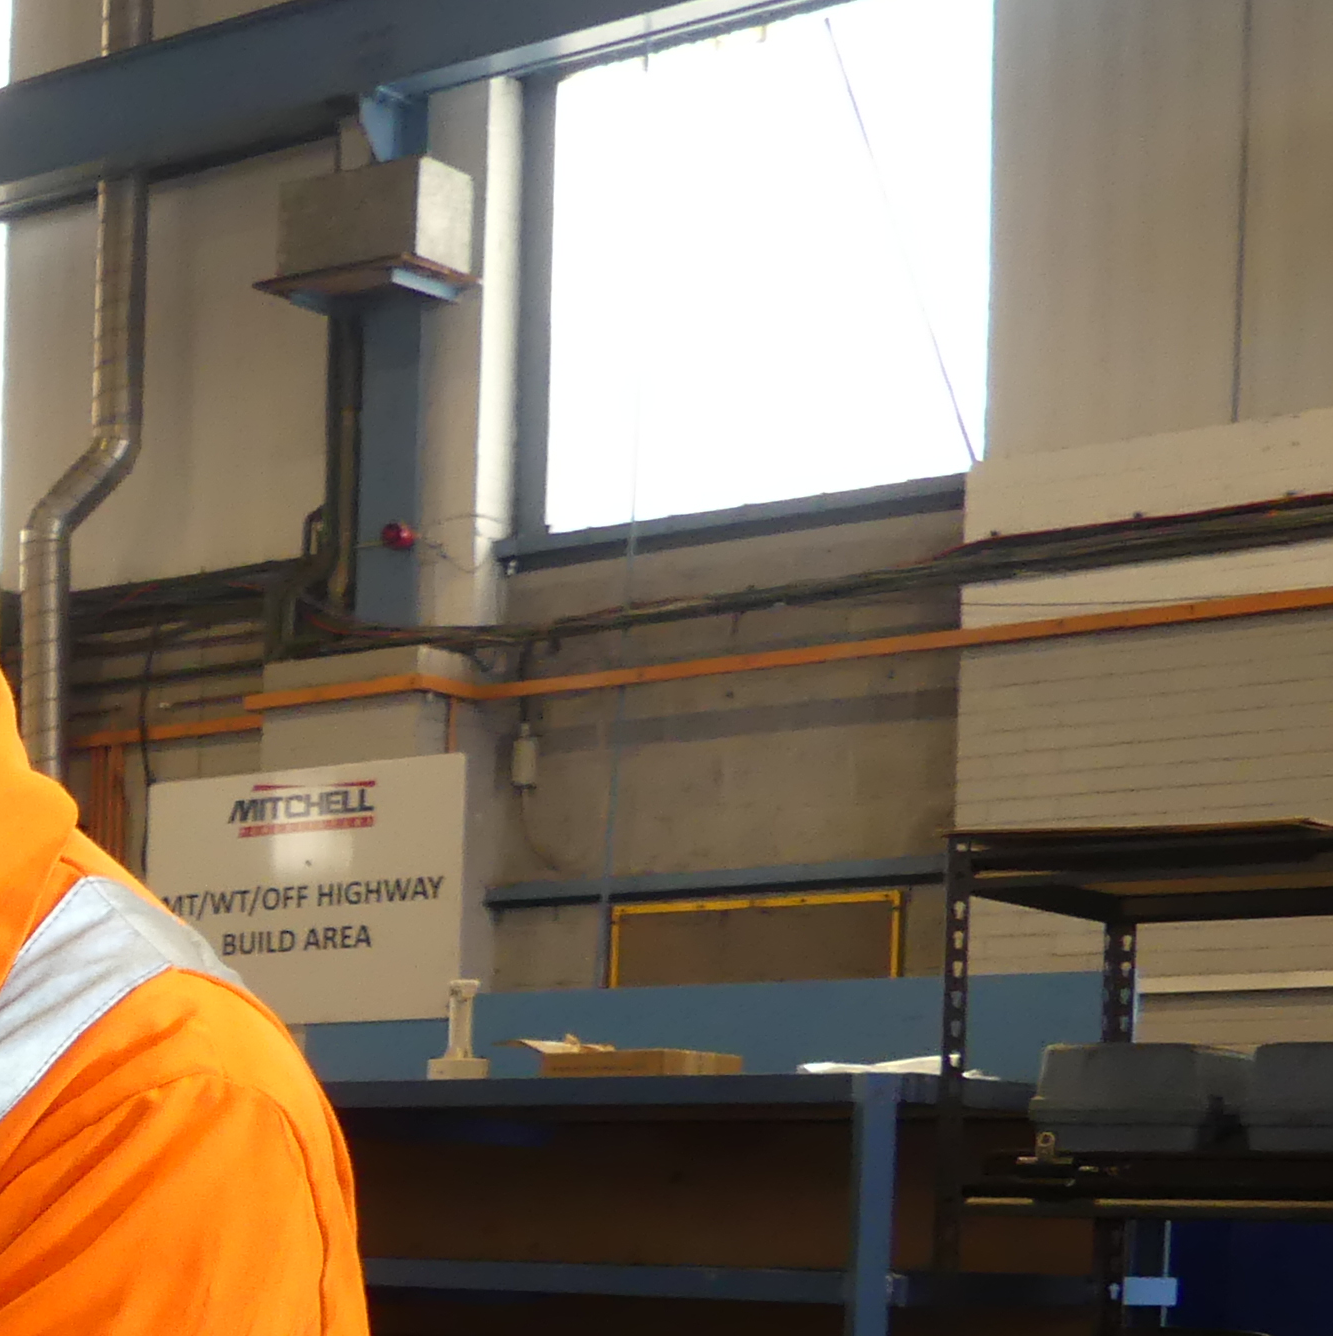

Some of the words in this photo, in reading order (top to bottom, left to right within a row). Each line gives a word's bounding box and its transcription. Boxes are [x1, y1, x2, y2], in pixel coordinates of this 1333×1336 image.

[228, 788, 375, 824] MITCHELL
[317, 875, 445, 907] HIGHWAY
[222, 929, 295, 956] BUILD
[304, 925, 372, 950] AREA
